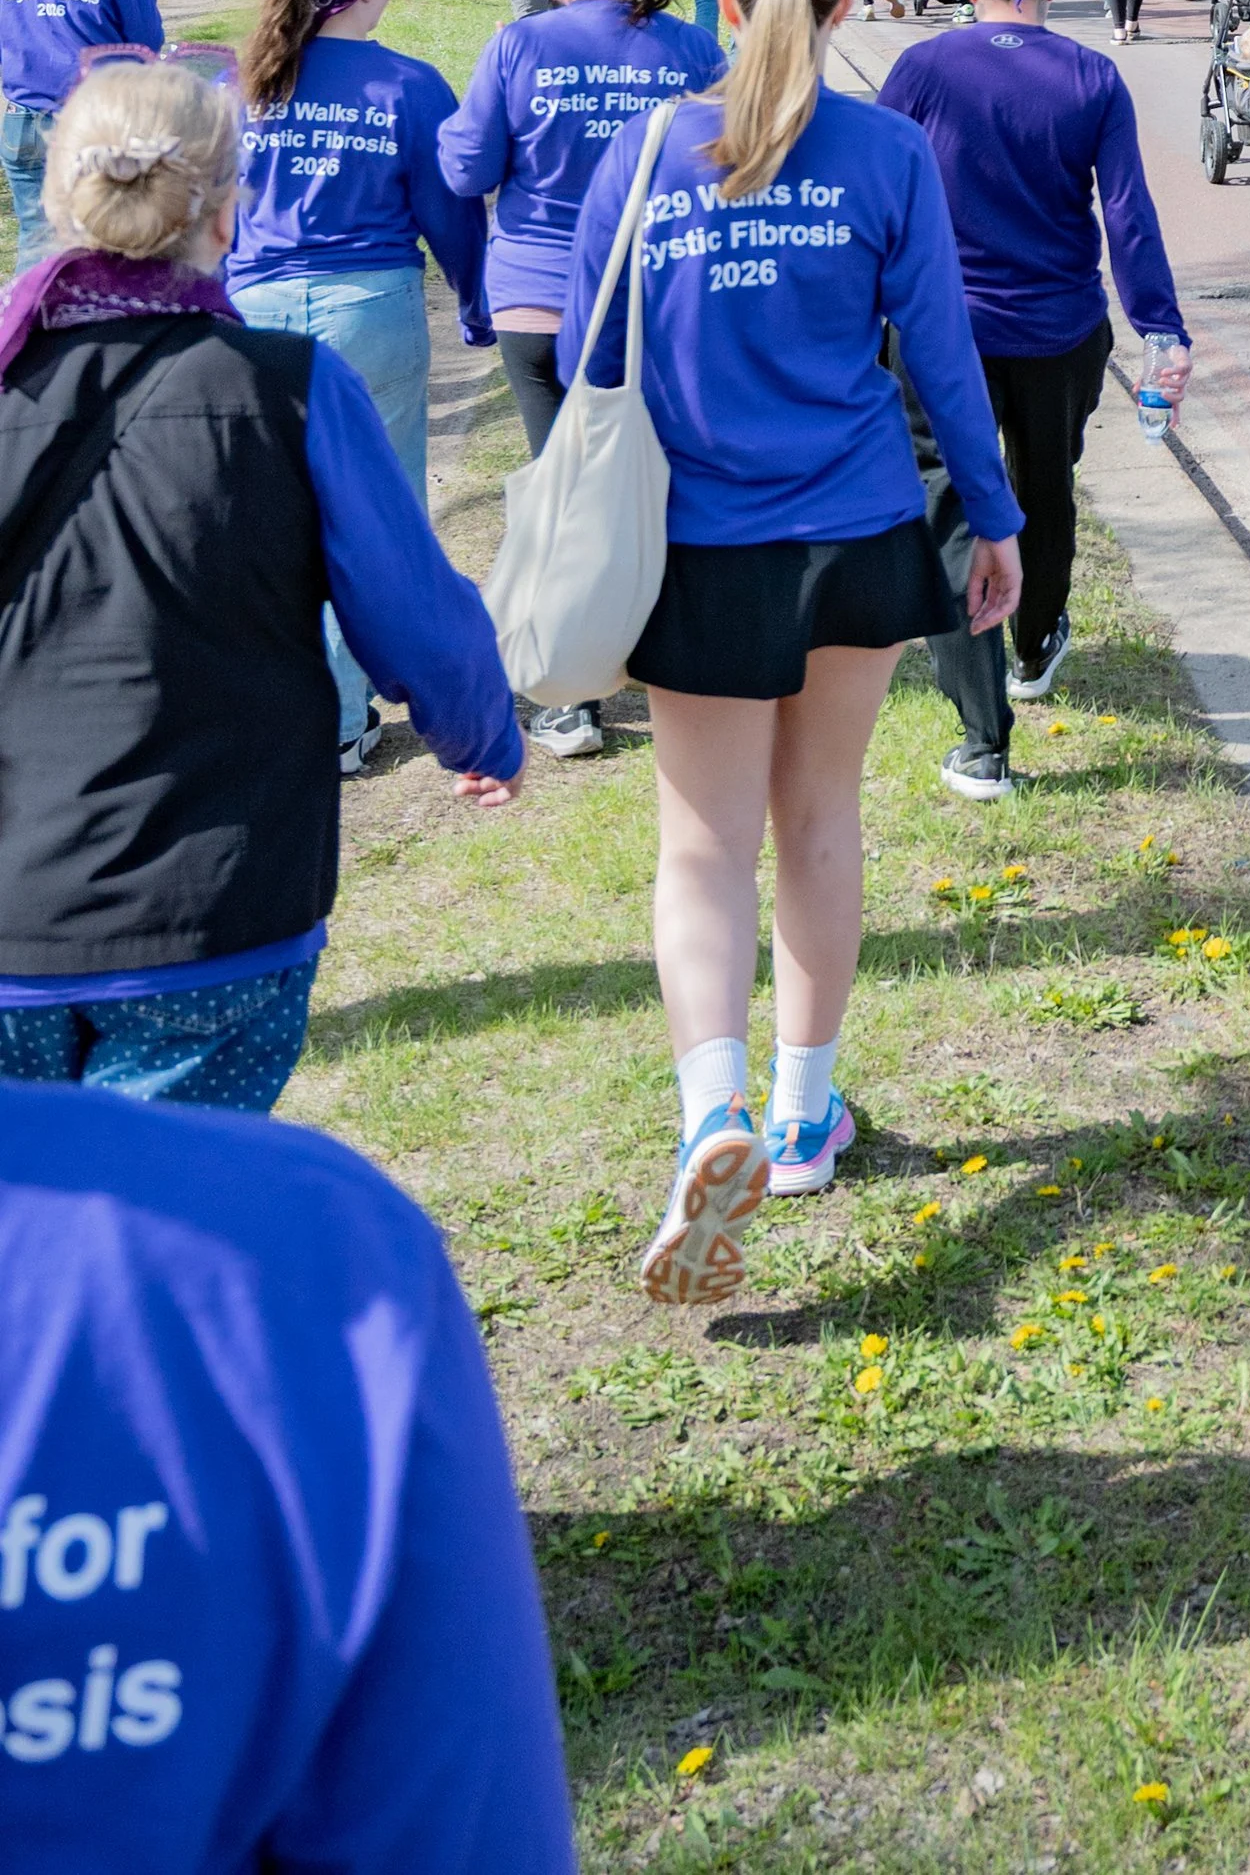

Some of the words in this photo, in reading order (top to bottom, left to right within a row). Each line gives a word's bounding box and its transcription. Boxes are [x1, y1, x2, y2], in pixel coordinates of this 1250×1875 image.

[536, 65, 579, 88] B29
[584, 65, 652, 85] Walks
[657, 65, 688, 86] for
[294, 102, 360, 123] Walks
[364, 105, 398, 129] for
[530, 93, 599, 119] Cystic
[242, 129, 306, 153] Cystic
[312, 129, 399, 156] Fibrosis
[584, 119, 625, 139] 202
[290, 156, 341, 177] 2026
[799, 178, 845, 208] for
[730, 219, 851, 249] Fibrosis
[709, 258, 778, 293] 2026
[0, 1493, 169, 1610] for
